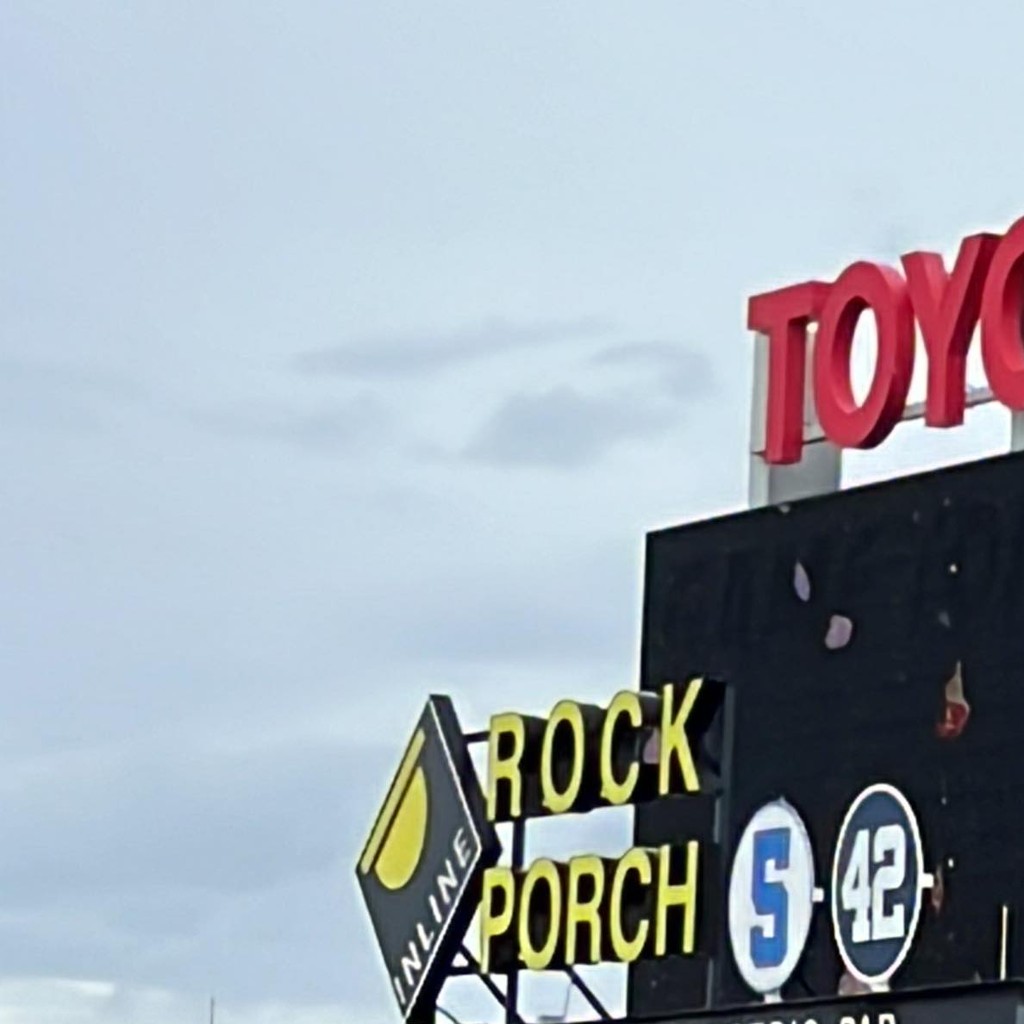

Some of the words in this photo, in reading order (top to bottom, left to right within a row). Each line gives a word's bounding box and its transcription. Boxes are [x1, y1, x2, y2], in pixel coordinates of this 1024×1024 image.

[486, 678, 704, 821] ROCK
[394, 827, 472, 1005] INLINE
[480, 840, 699, 974] PORCH
[842, 824, 906, 943] 42
